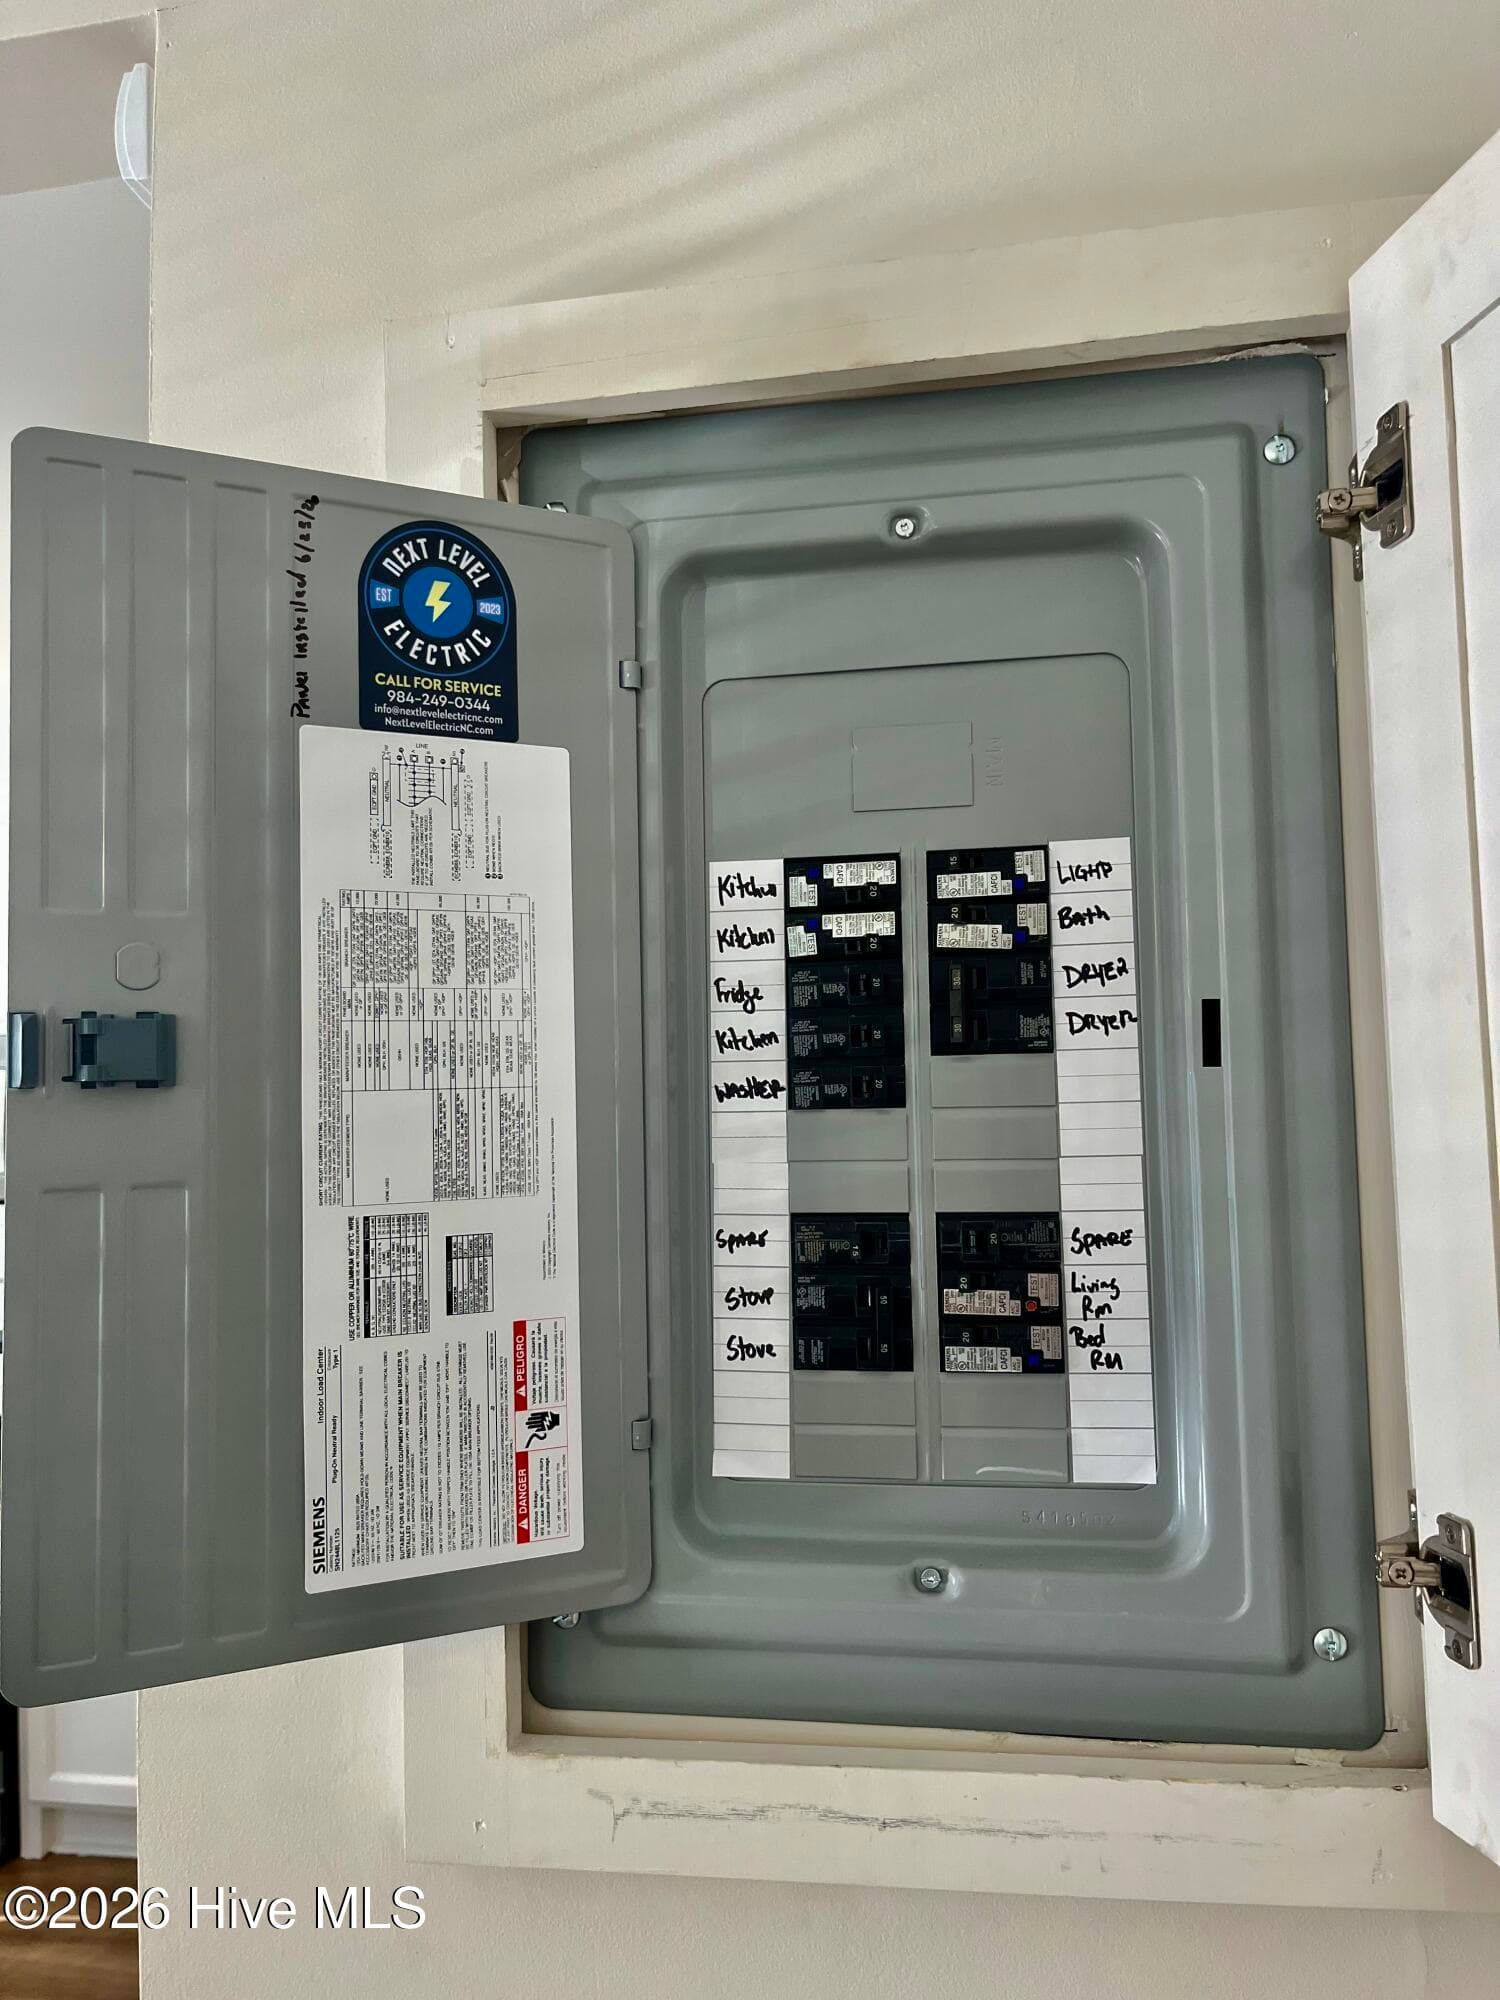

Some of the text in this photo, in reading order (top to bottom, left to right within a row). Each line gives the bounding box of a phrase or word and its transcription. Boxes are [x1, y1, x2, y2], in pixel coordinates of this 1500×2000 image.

[382, 538, 491, 588] NEXT LEVEL
[375, 587, 392, 602] EST
[479, 602, 501, 616] 2023
[383, 619, 492, 667] ELECTRIC
[374, 672, 502, 697] CALL FOR SERVICE
[387, 690, 491, 712] 984-249-0344
[374, 703, 503, 725] info@nextlevelelectricnc.com
[384, 717, 494, 736] NextLevelElectricNC.com
[950, 856, 957, 865] 15
[870, 886, 877, 897] 20
[951, 907, 958, 918] 20
[807, 934, 816, 953] TEST
[870, 937, 877, 949] 20
[872, 978, 880, 987] 20
[713, 976, 764, 1014] Fridge
[874, 1030, 881, 1039] 20
[954, 1024, 962, 1032] 30
[875, 1079, 883, 1089] 20
[990, 1233, 998, 1244] 20
[852, 1245, 858, 1257] 15
[960, 1277, 967, 1289] 20
[1029, 1275, 1038, 1295] TEST
[1071, 1271, 1120, 1300] Living
[348, 1292, 354, 1300] OR
[998, 1292, 1006, 1314] CAFCI
[962, 1332, 970, 1343] 20
[1032, 1328, 1040, 1348] TEST
[1068, 1322, 1106, 1348] Bed
[726, 1334, 777, 1362] Stove
[880, 1344, 888, 1353] 50
[516, 1335, 525, 1382] PELIGRO
[1000, 1349, 1008, 1370] CAFCI
[518, 1468, 527, 1514] DANGER
[312, 1496, 326, 1575] SIEMENS
